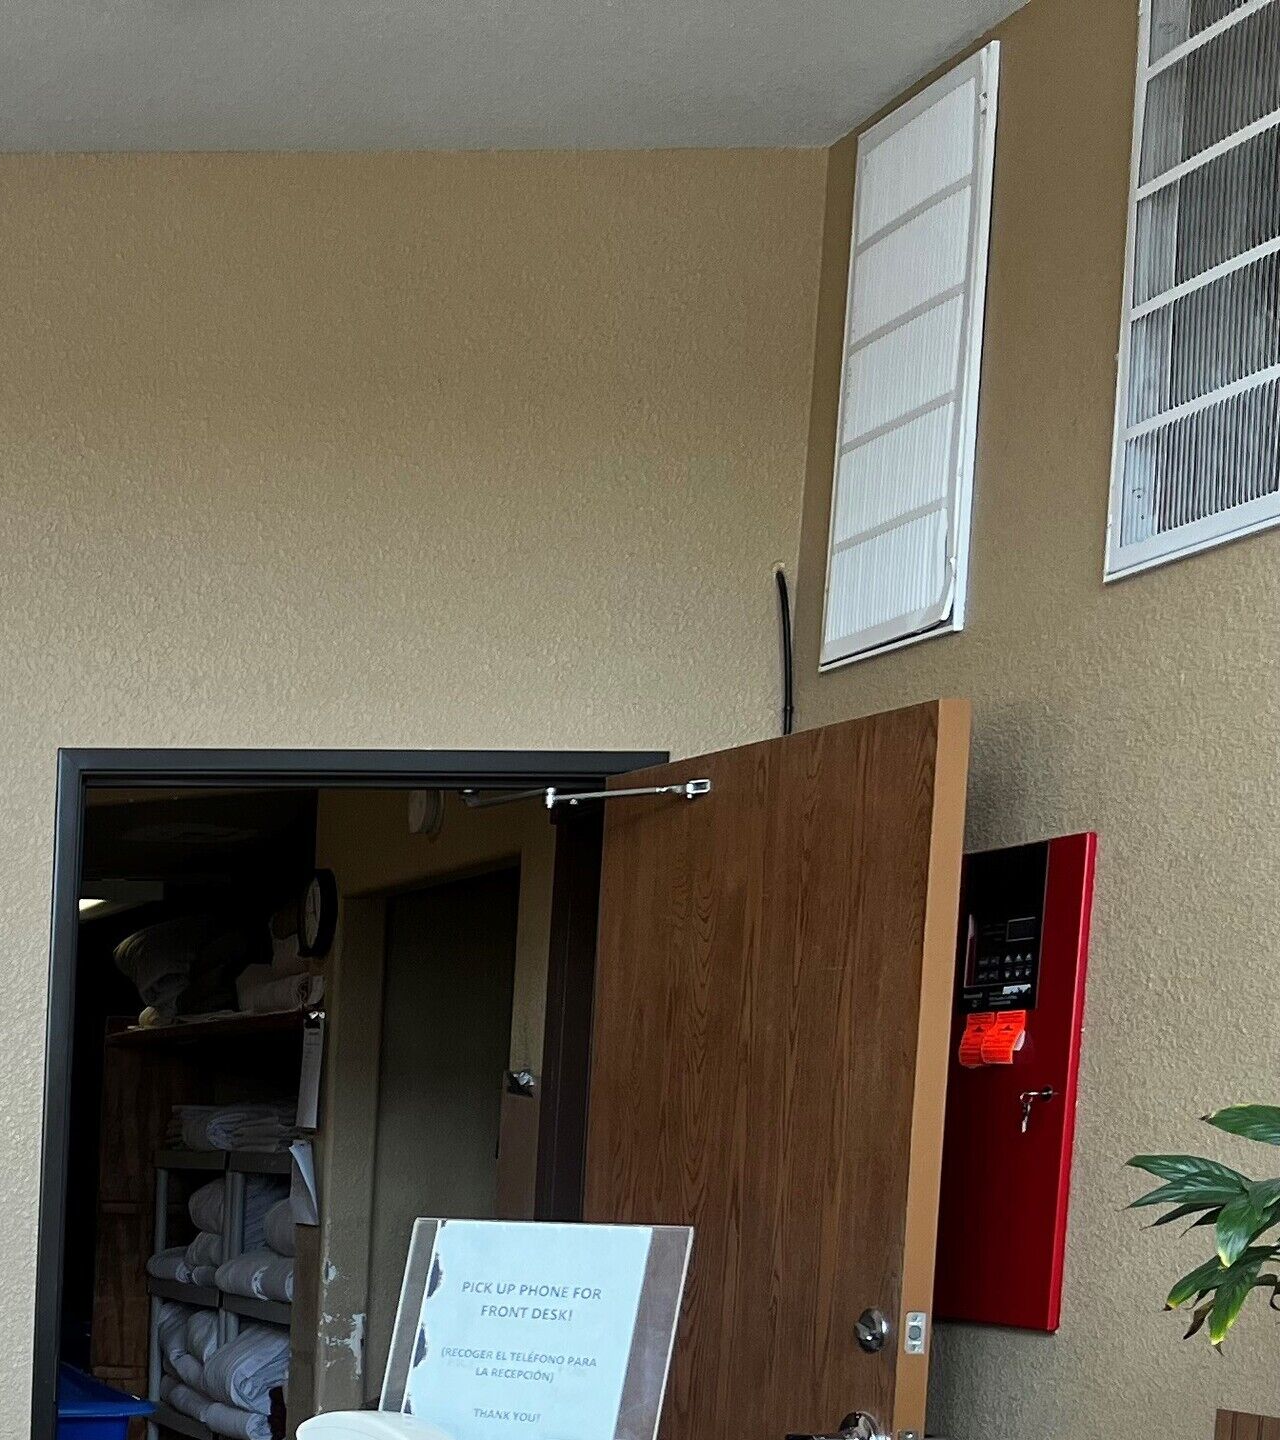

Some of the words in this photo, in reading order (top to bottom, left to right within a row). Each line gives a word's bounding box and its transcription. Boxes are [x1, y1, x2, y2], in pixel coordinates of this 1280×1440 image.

[462, 1281, 493, 1293] PICK
[496, 1283, 516, 1295] UP
[519, 1284, 568, 1298] PHONE
[573, 1287, 602, 1300] FOR
[480, 1305, 529, 1319] FRONT
[531, 1308, 573, 1321] DESK!
[441, 1346, 493, 1361] (RECOGER
[496, 1351, 506, 1361] EL
[510, 1351, 565, 1365] TELÉFONO
[567, 1356, 597, 1367] PARA
[475, 1366, 488, 1377] LA
[491, 1367, 554, 1383] RECEPCIÓN)
[474, 1408, 510, 1420] THANK
[513, 1411, 541, 1423] YOU!
